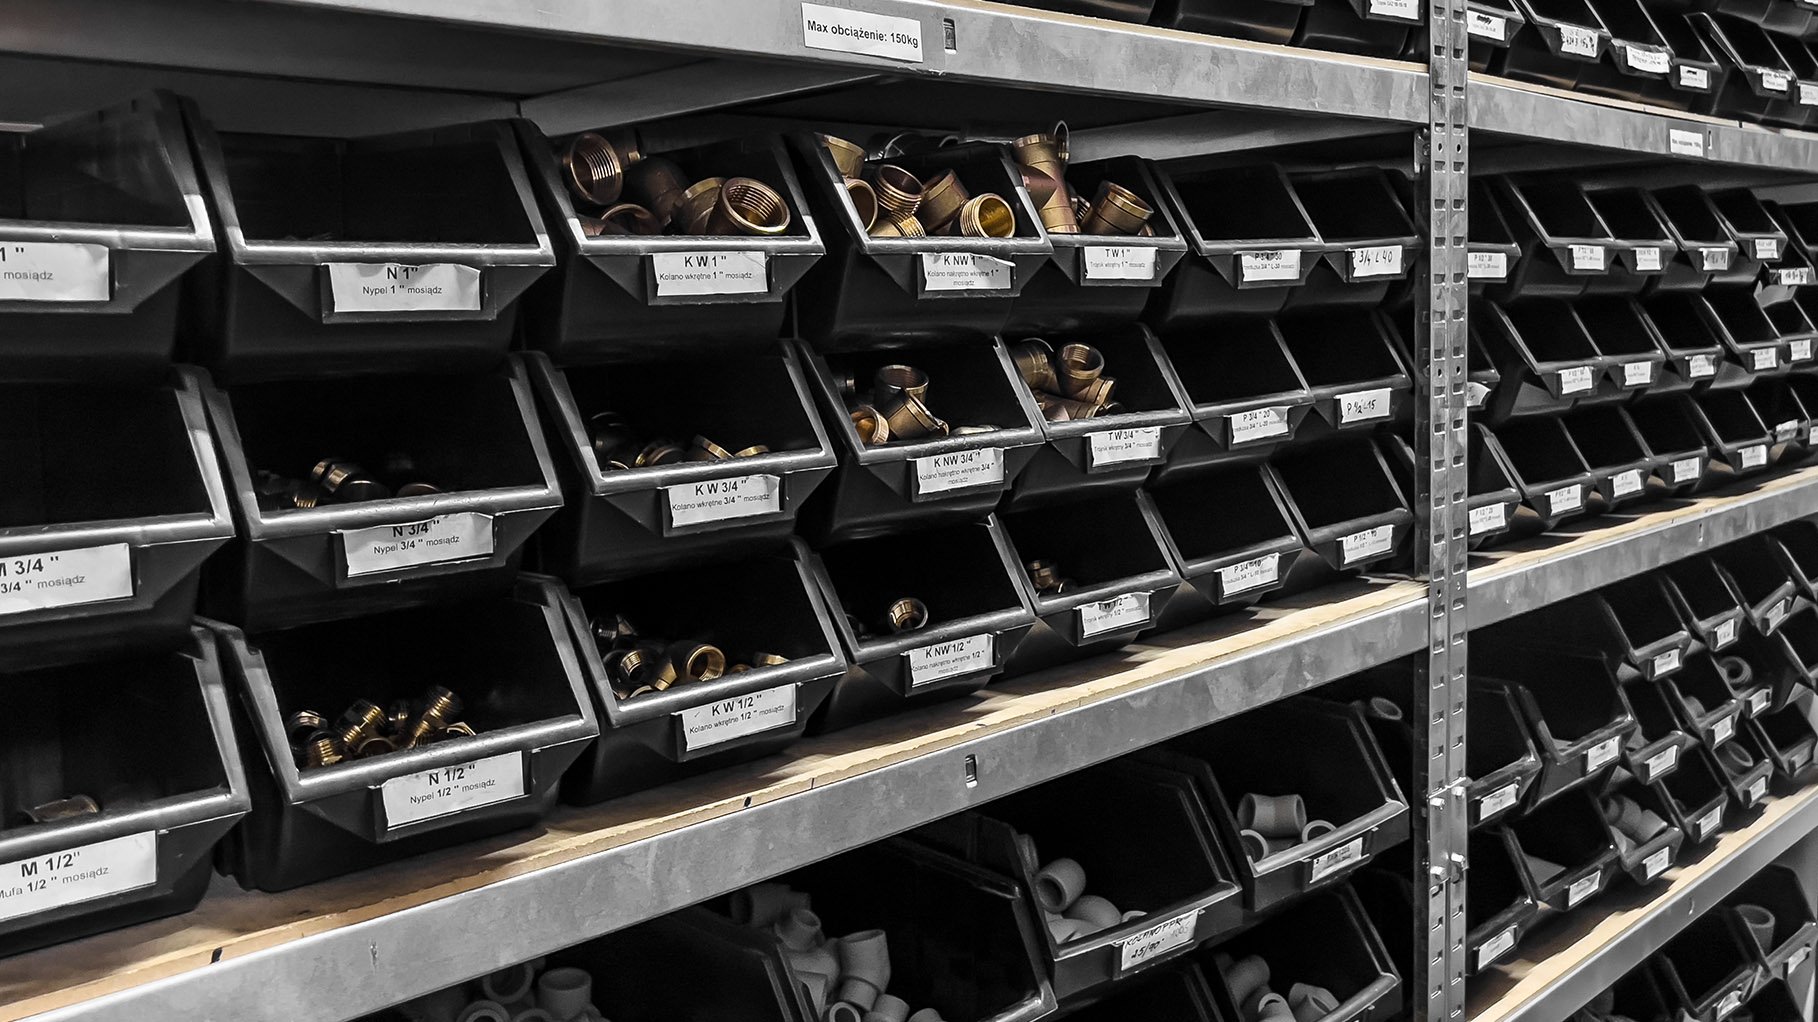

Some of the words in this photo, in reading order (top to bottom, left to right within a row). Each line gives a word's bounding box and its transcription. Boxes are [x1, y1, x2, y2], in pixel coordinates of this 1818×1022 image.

[807, 20, 829, 33] Max
[831, 24, 888, 42] obciążenie:
[890, 32, 919, 48] 150kg
[943, 256, 951, 265] K
[953, 255, 969, 265] NW
[1105, 248, 1110, 257] T
[1111, 248, 1119, 257] W
[684, 255, 694, 267] K
[696, 255, 708, 267] W
[4, 270, 54, 281] mosiądz
[387, 267, 398, 279] N
[659, 273, 684, 281] Kolano
[363, 286, 388, 296] Nypel
[407, 285, 443, 296] mosiądz
[1108, 431, 1113, 440] T
[1115, 431, 1122, 440] W
[933, 458, 941, 467] K
[943, 455, 958, 466] NW
[695, 484, 704, 496] K
[707, 482, 718, 494] W
[722, 480, 738, 493] 3/4
[672, 503, 696, 512] Kolano
[392, 526, 404, 537] N
[407, 522, 430, 535] 3/4
[374, 545, 399, 555] Nypel
[426, 535, 460, 548] mosiądz
[14, 558, 45, 576] 3/4
[37, 574, 86, 590] mosiądz
[926, 648, 932, 658] K
[934, 645, 950, 656] NW
[952, 642, 965, 653] 1/2
[711, 705, 721, 717] K
[723, 701, 735, 713] W
[737, 696, 754, 709] 1/2
[689, 723, 713, 735] Kolano
[428, 772, 439, 786] N
[444, 767, 465, 782] 1/2
[410, 793, 435, 804] Nypel
[437, 787, 452, 798] 1/2
[461, 779, 496, 793] mosiądz
[21, 861, 39, 877] M
[27, 879, 47, 892] 1/2
[62, 866, 110, 884] mosiądz
